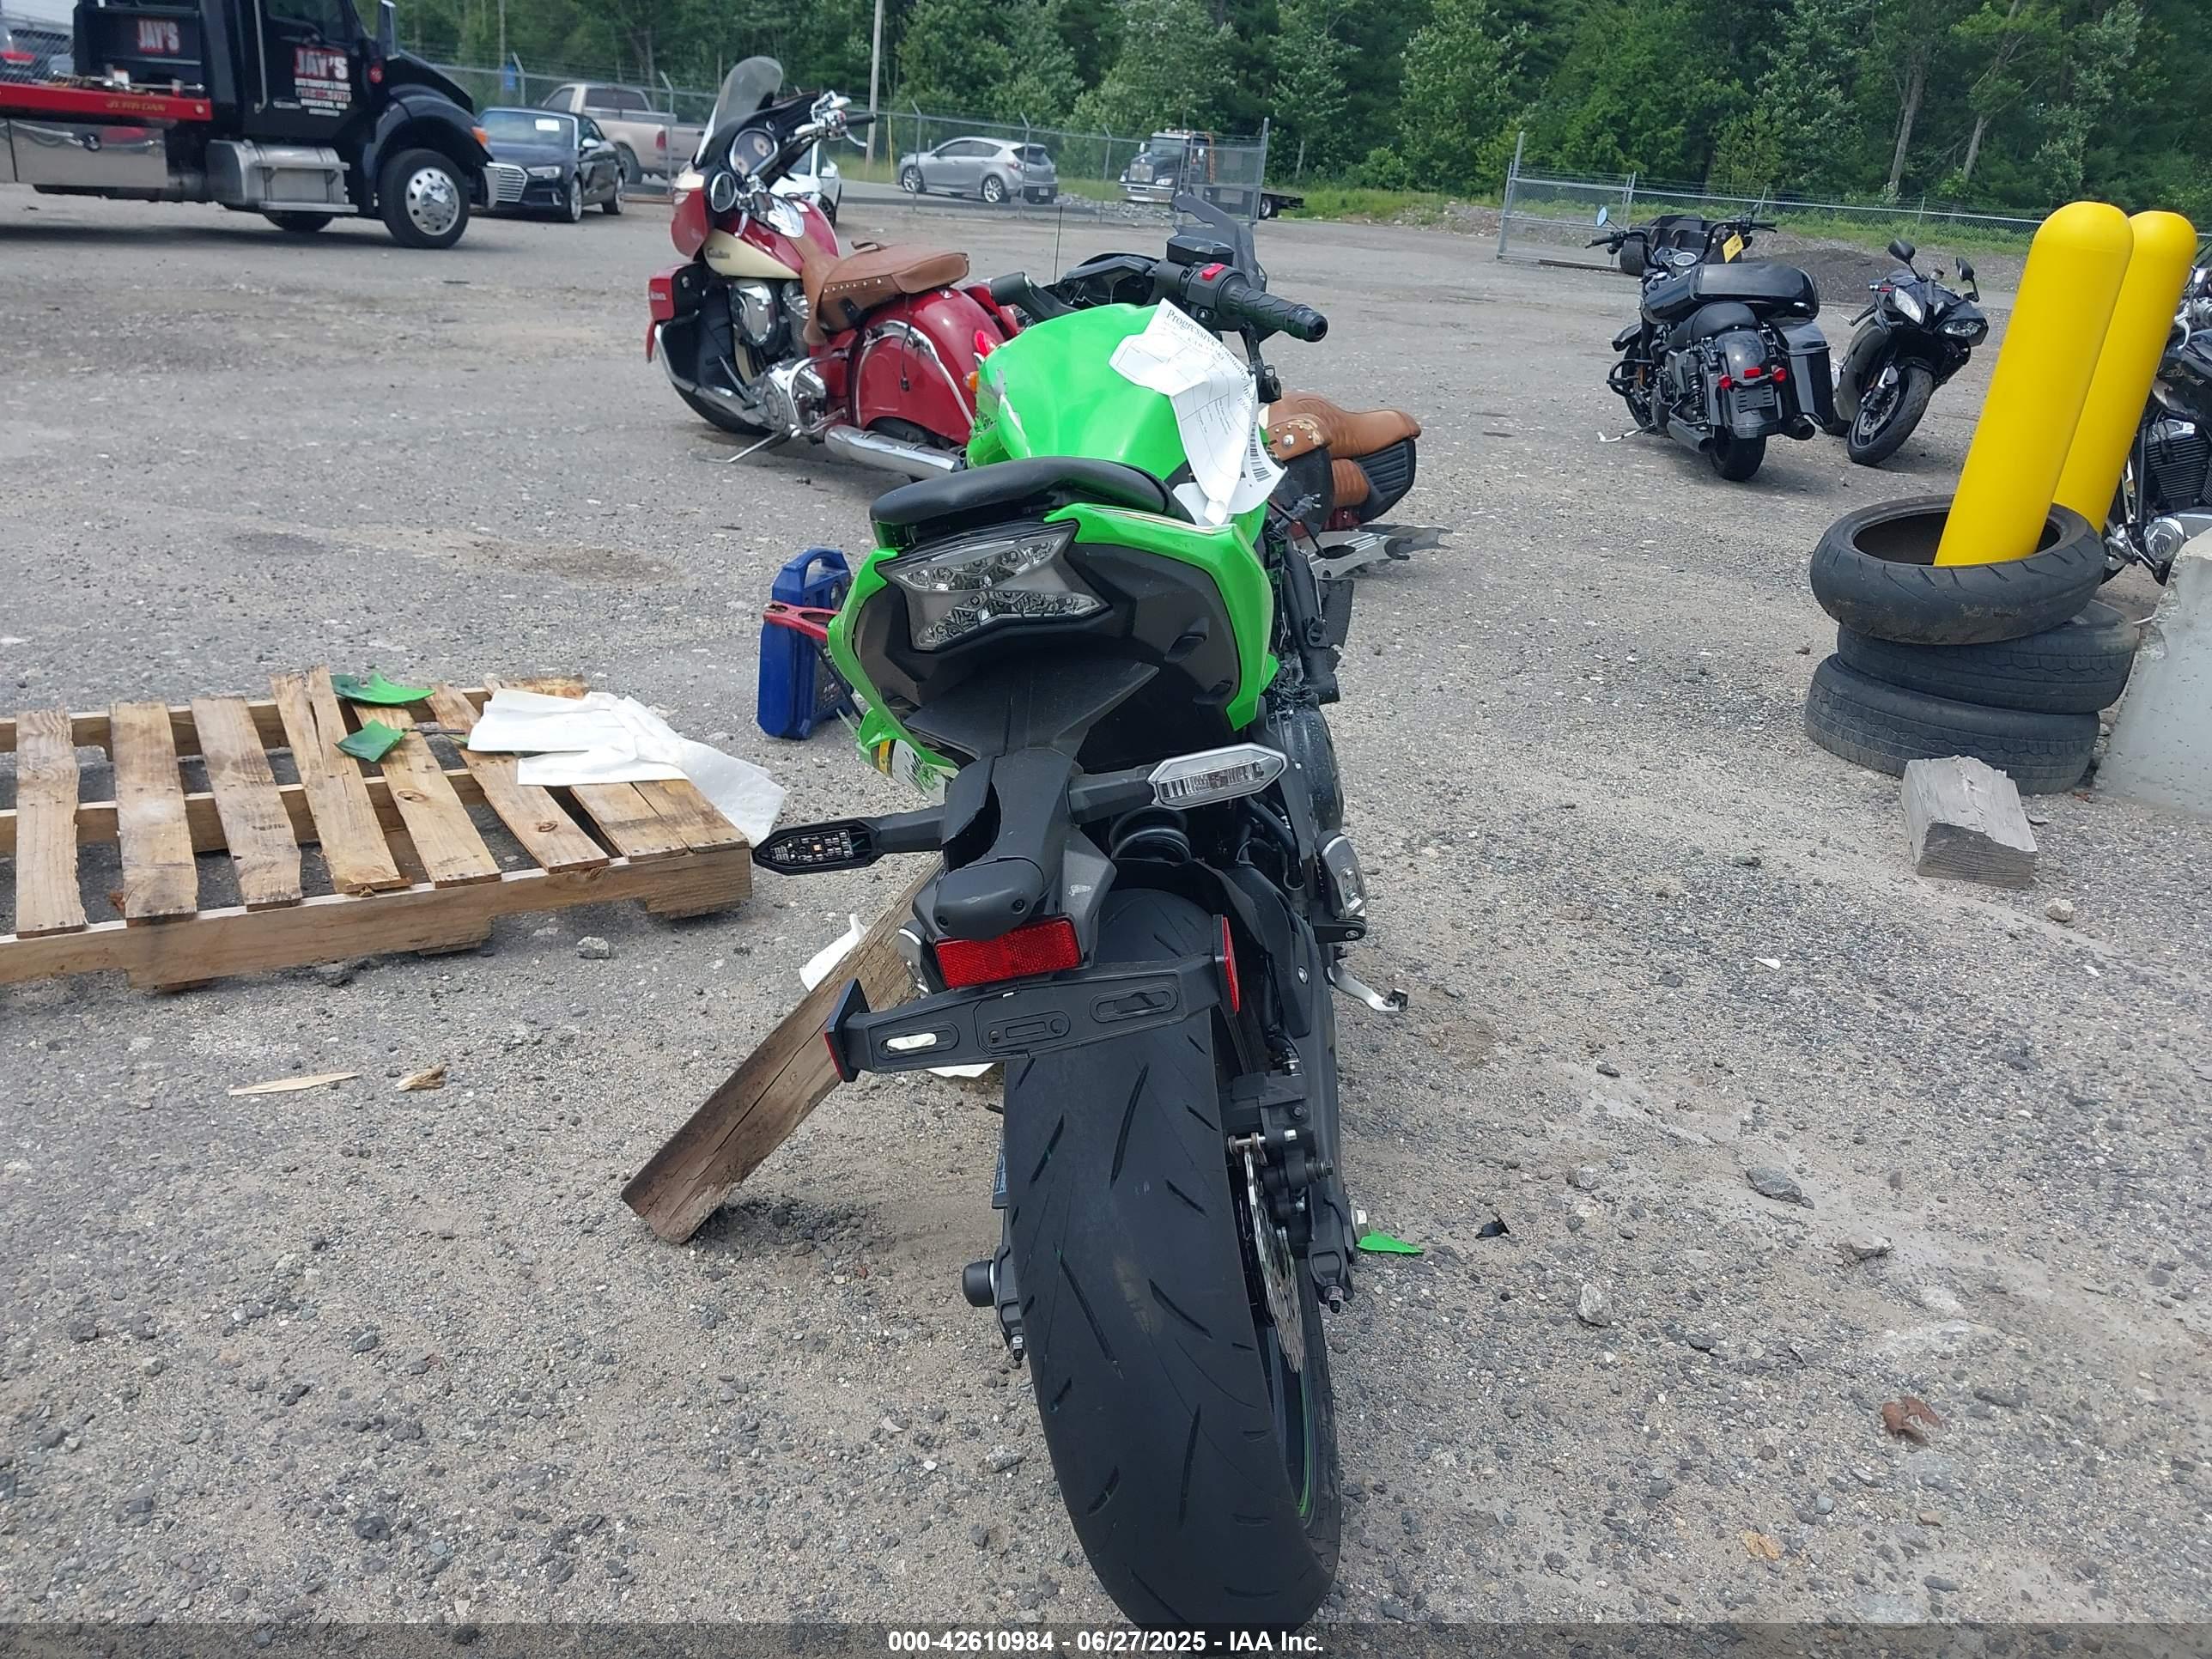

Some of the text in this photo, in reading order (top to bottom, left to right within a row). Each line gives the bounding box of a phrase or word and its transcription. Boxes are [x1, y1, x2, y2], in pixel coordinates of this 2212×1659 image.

[138, 20, 179, 52] JAY'S
[295, 48, 349, 81] JAY'S
[1166, 308, 1218, 347] Progressive
